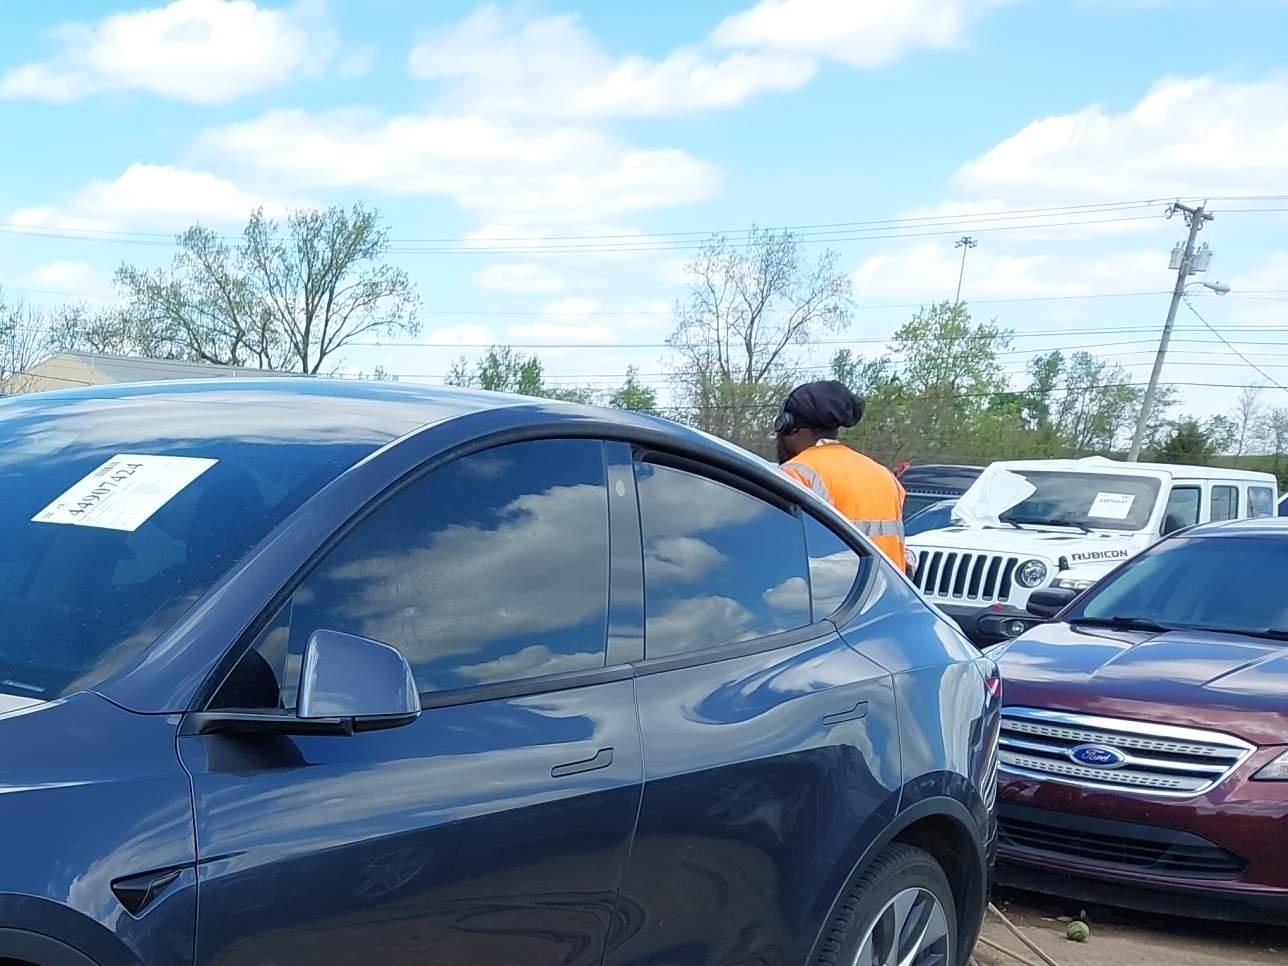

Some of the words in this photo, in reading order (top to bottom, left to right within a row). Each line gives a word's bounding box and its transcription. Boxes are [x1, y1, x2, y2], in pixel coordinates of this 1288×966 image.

[68, 463, 144, 517] 44907424
[1071, 549, 1129, 561] RUBICON
[1081, 749, 1112, 761] Ford
